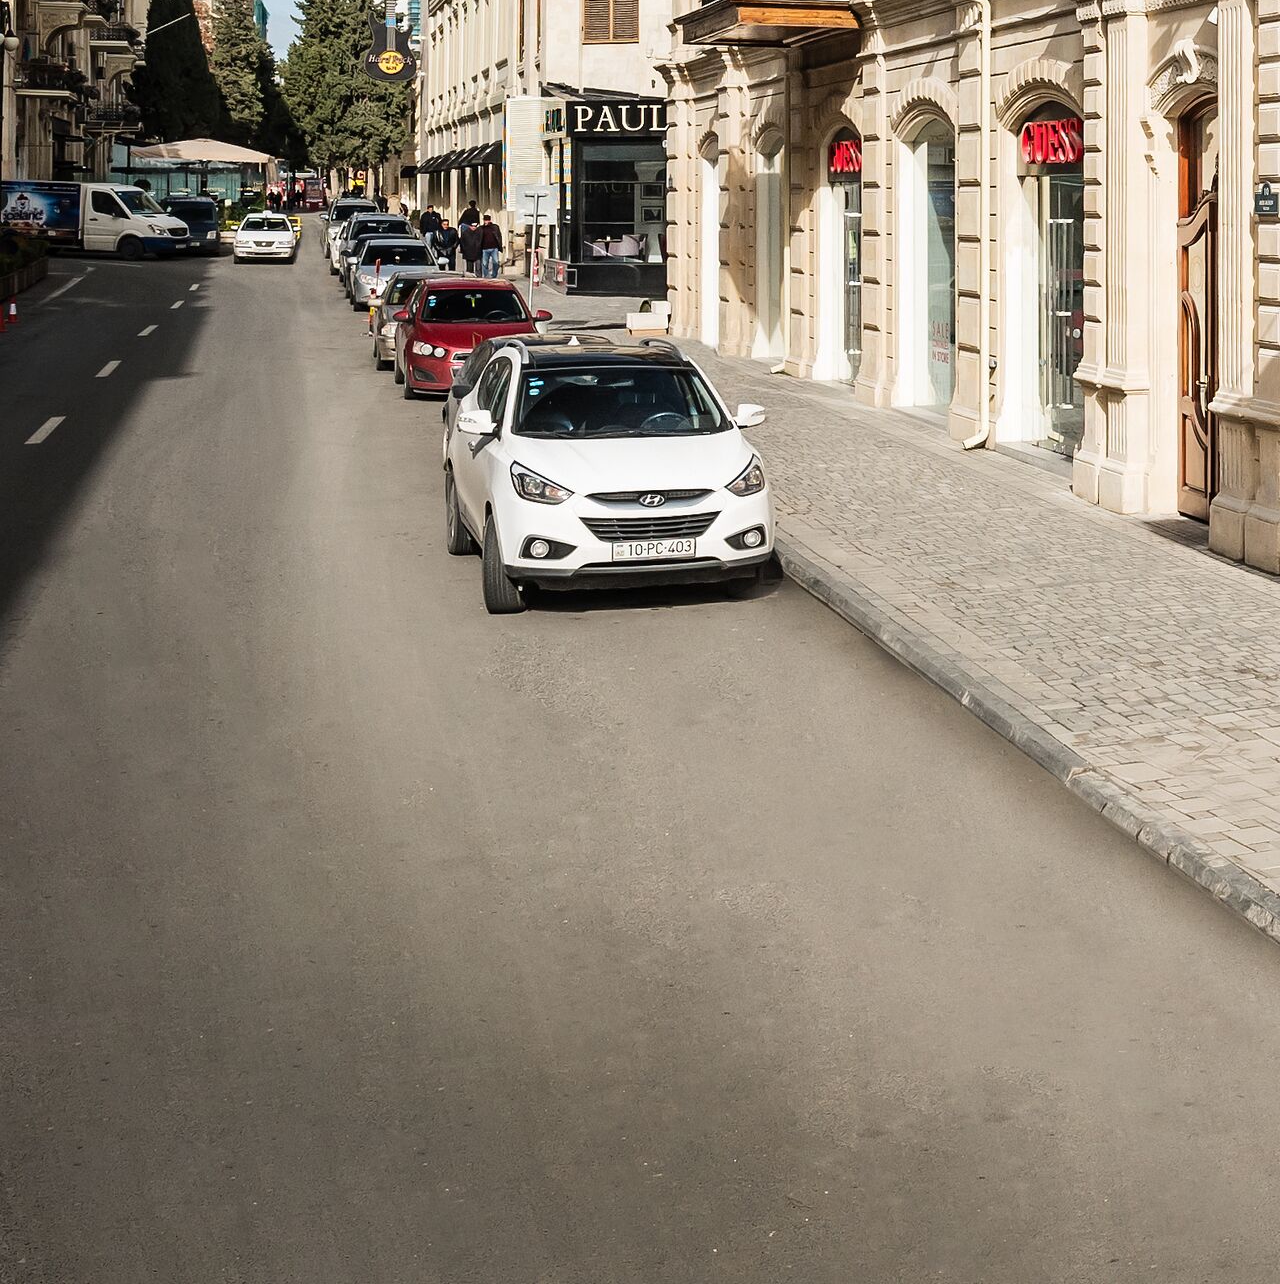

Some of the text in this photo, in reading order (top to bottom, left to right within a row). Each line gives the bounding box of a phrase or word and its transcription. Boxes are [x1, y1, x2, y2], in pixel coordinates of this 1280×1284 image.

[368, 54, 391, 64] Hard
[573, 105, 669, 132] PAUL
[1021, 118, 1082, 164] GUESS
